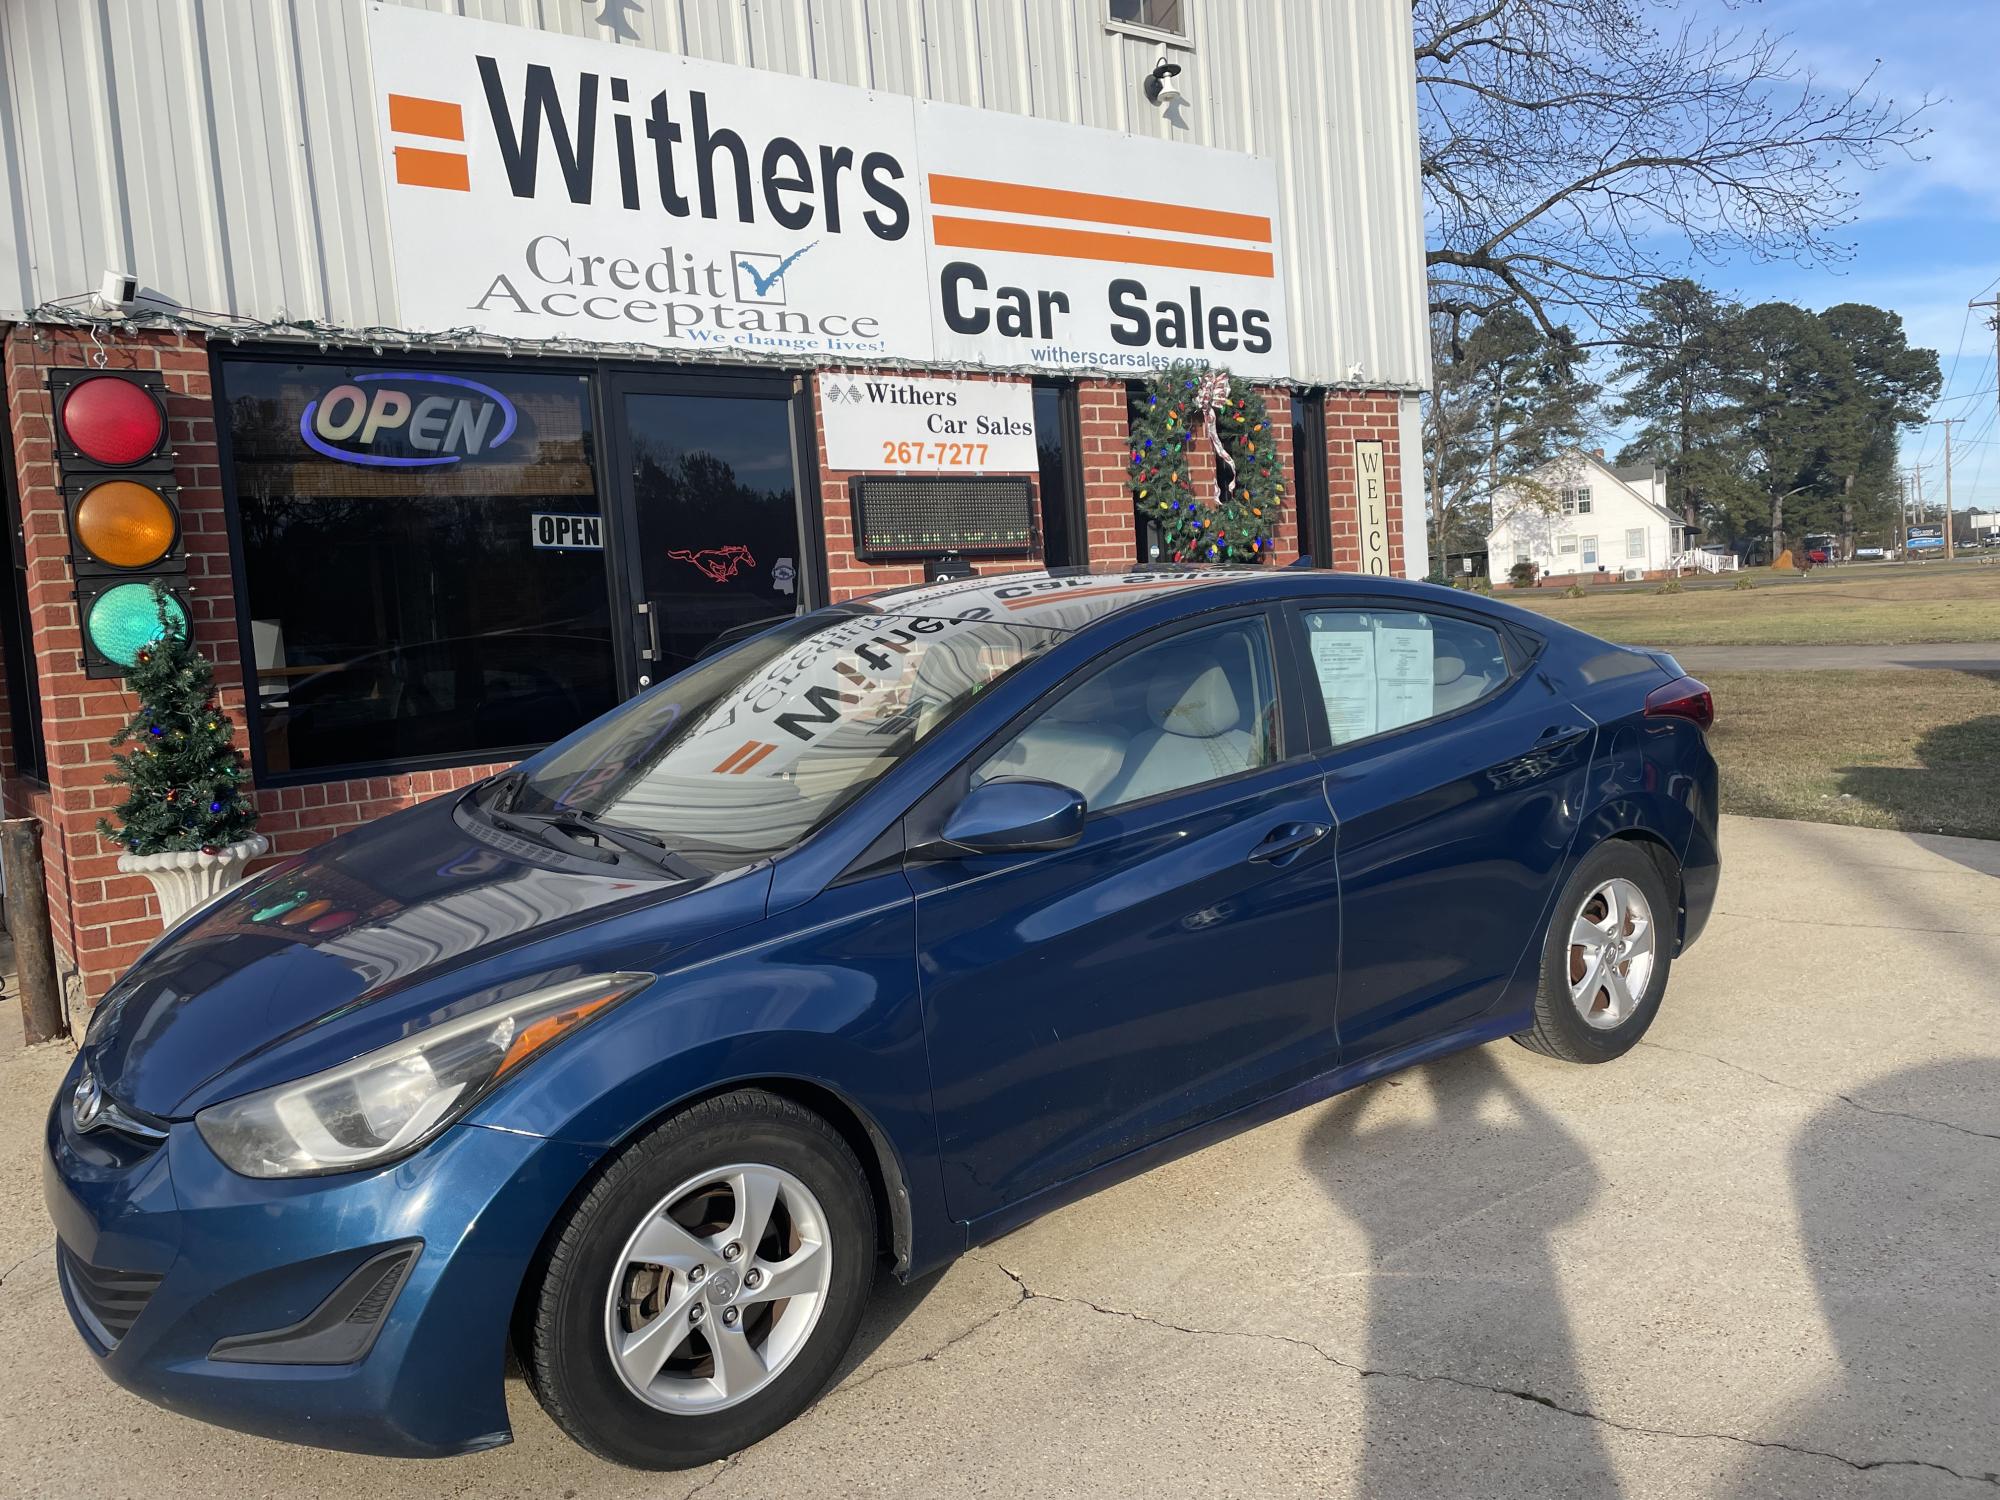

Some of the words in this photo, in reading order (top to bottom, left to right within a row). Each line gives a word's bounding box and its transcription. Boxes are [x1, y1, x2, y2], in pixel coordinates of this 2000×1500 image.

[475, 54, 910, 242] Withers
[525, 234, 728, 299] Credit
[467, 273, 881, 338] Acceptance
[940, 261, 1071, 340] Car
[1108, 278, 1273, 354] Sales
[687, 328, 726, 344] We
[734, 332, 819, 351] change
[827, 338, 886, 353] lives!
[1031, 346, 1209, 369] witherscarsalescom
[865, 382, 958, 407] Withers
[316, 384, 496, 456] OPEN
[927, 413, 968, 434] Car
[976, 415, 1034, 436] Sales
[882, 441, 989, 466] 267-7277
[538, 515, 600, 547] OPEN
